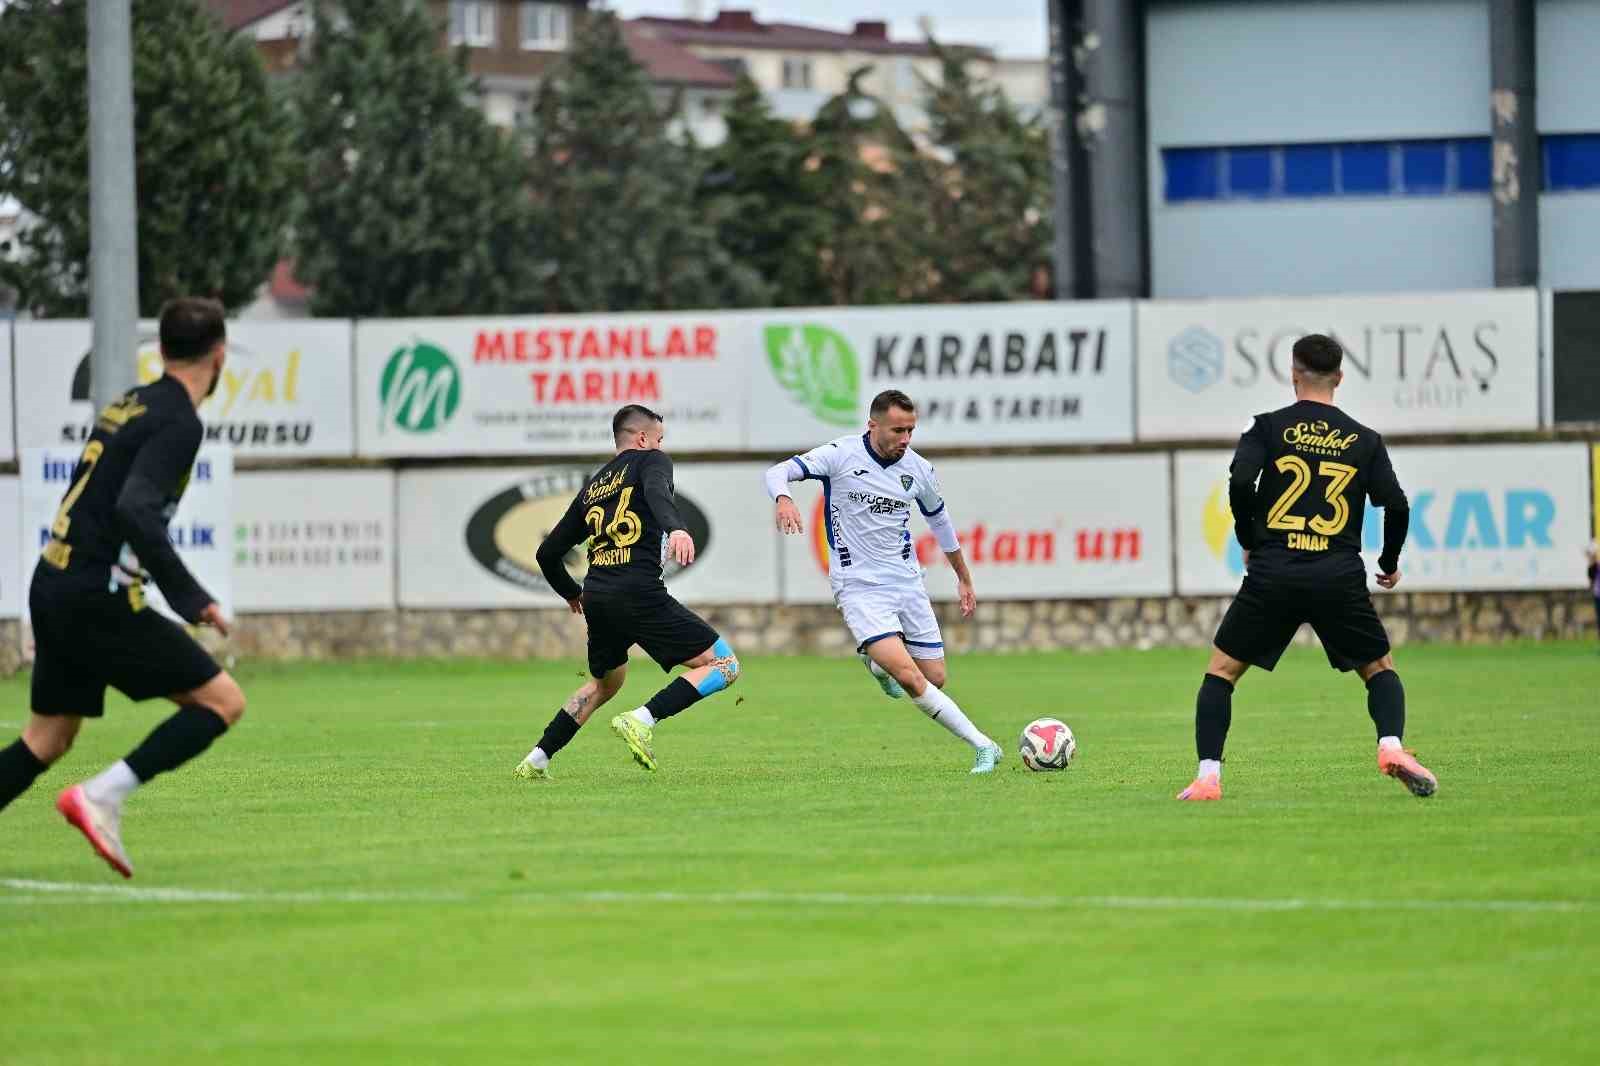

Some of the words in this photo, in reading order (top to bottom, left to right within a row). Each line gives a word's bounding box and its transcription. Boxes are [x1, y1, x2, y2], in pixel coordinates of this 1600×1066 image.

[474, 327, 717, 364] MESTANLAR
[872, 328, 1108, 379] KARABATI
[530, 368, 661, 404] TARIM
[993, 396, 1082, 419] TARIM
[206, 423, 312, 446] KURSU
[1283, 422, 1358, 450] Sembol
[1266, 454, 1358, 535] 23
[584, 486, 642, 549] 26
